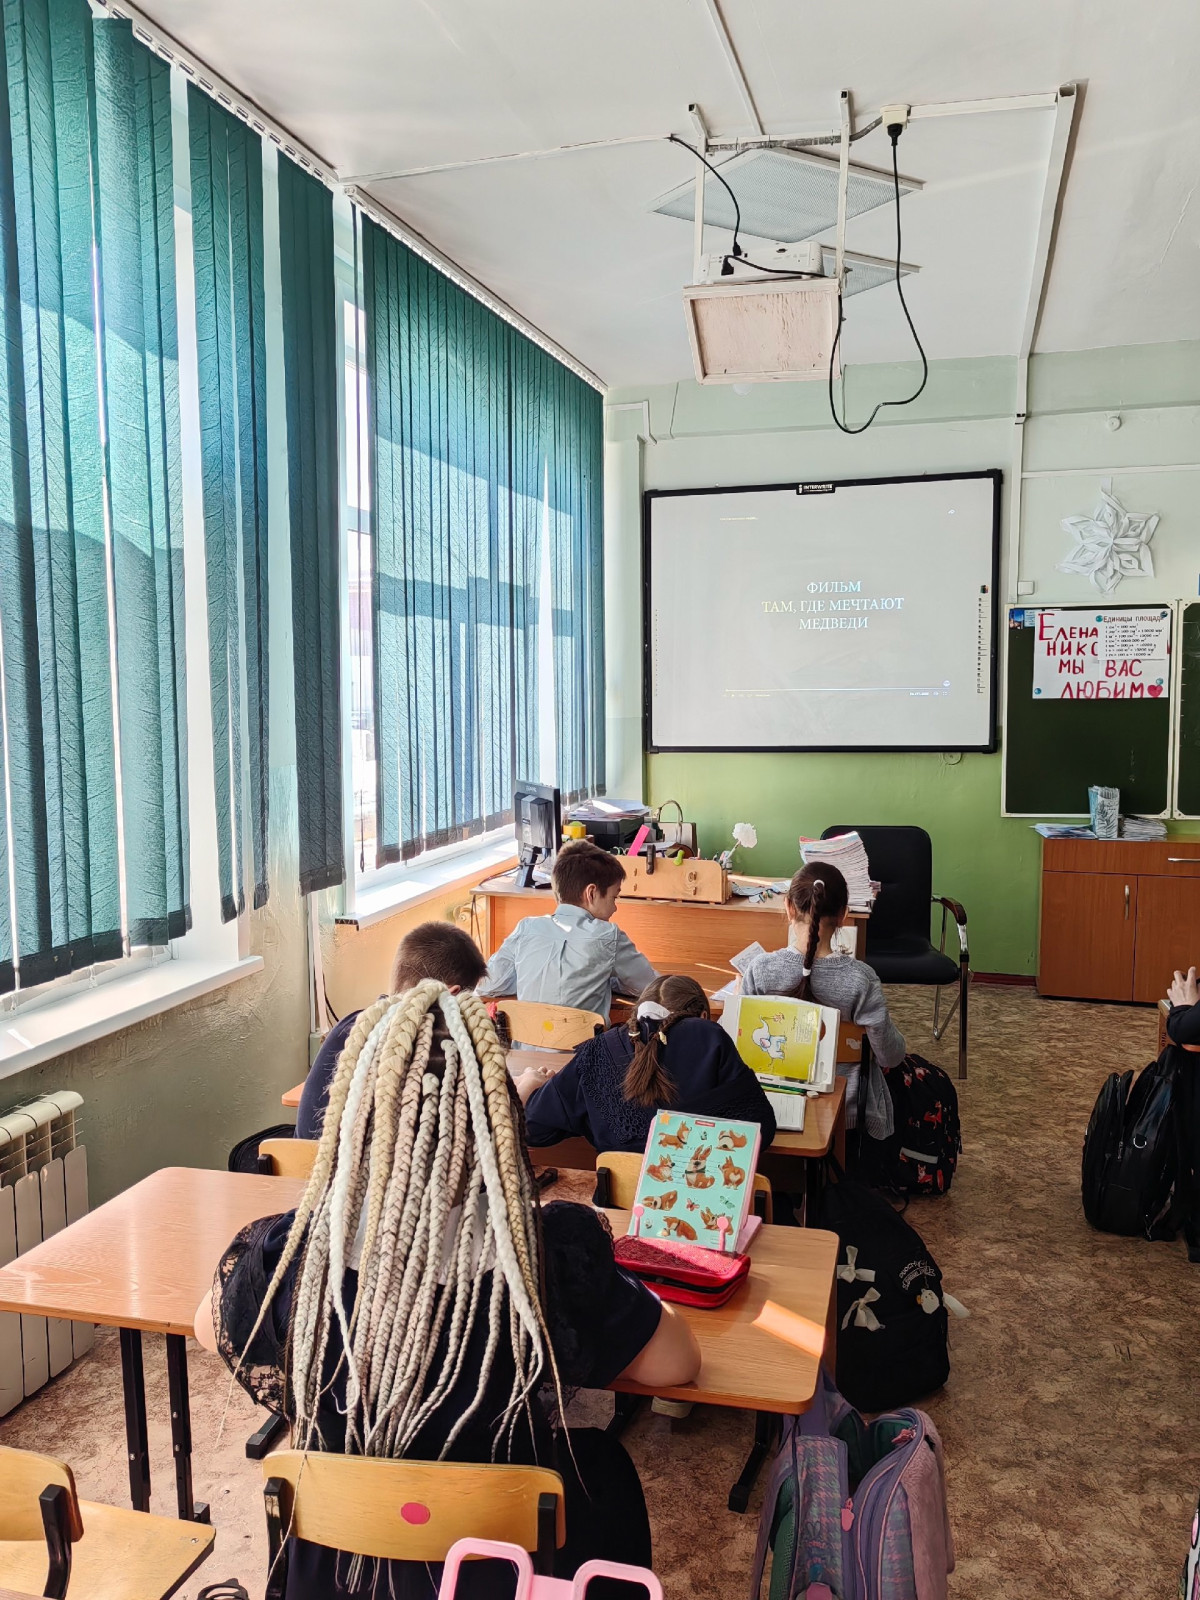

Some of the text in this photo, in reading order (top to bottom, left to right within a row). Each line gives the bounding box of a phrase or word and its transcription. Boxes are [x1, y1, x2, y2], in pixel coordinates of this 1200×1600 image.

[806, 580, 862, 593] ФИЛЬМ
[761, 597, 905, 613] ТАМ, ГДЕ МЕЧТАЮТ
[799, 616, 869, 631] МЕДВЕДИ
[1058, 658, 1143, 678] МЫ ВАС
[1060, 680, 1145, 699] ЛЮБИМ
